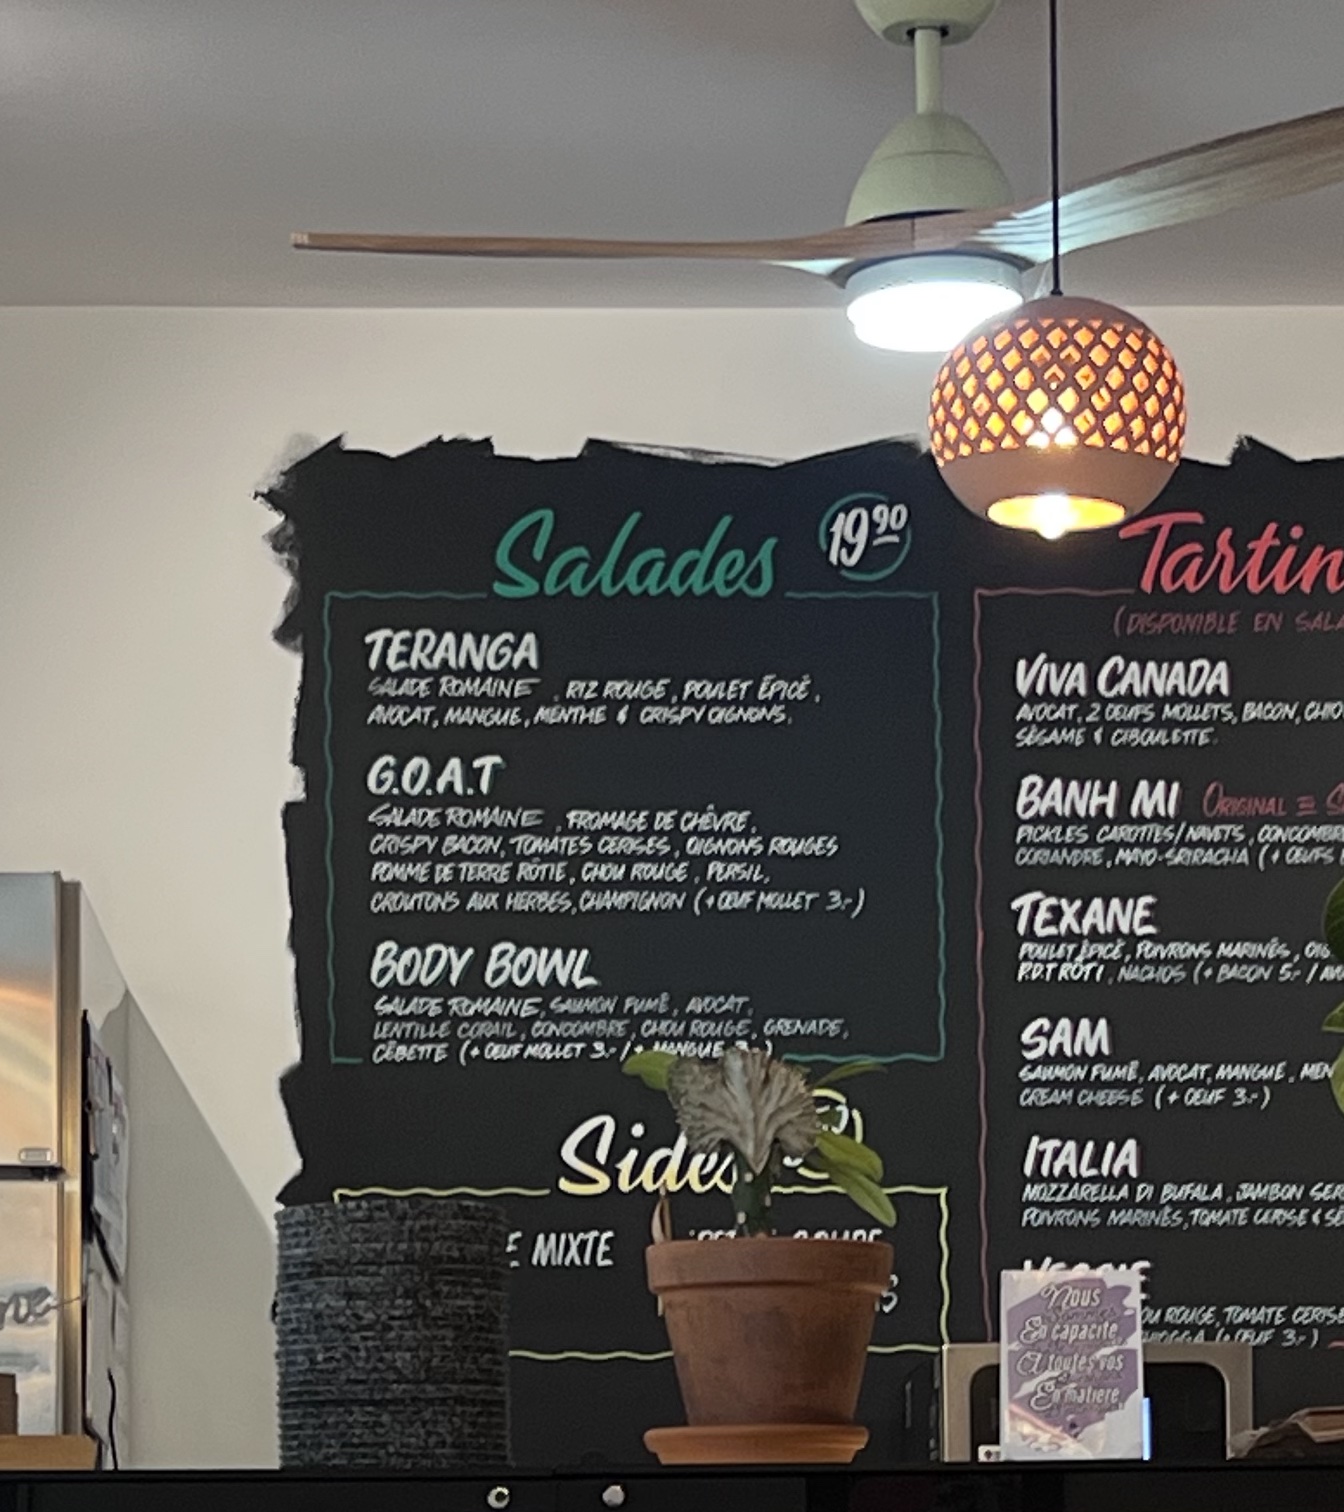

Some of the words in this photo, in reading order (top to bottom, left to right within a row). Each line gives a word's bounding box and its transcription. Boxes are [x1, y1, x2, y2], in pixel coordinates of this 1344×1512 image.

[493, 508, 778, 598] Salades
[1253, 610, 1282, 634] EN
[364, 628, 540, 672] TERANGA
[1016, 652, 1087, 698] VIVA
[1098, 655, 1231, 698] CANADA
[368, 677, 433, 698] SALADE
[566, 680, 598, 699] RIZ
[683, 680, 748, 699] POULET
[534, 706, 607, 724] MENTHE
[640, 706, 703, 724] CRISPY
[1087, 703, 1100, 722] 2
[1016, 774, 1117, 819] BANH
[1131, 780, 1182, 818] MI
[368, 804, 442, 828] SALADE
[566, 810, 649, 831] FROMAGE
[654, 812, 676, 830] DE
[1016, 823, 1088, 844] PICKLES
[369, 835, 438, 856] CRISPY
[510, 835, 593, 856] TOMATES
[685, 835, 763, 856] OIGNONS
[769, 835, 838, 856] ROUGES
[371, 862, 433, 883] POMME
[435, 862, 455, 883] DE
[459, 862, 513, 883] TERRE
[582, 862, 625, 881] CHOU
[467, 891, 499, 909] AUX
[580, 891, 685, 910] CHAMPIGNON
[757, 891, 812, 910] MOLLET
[1010, 891, 1159, 937] TEXANE
[1136, 942, 1212, 960] POIVRONS
[370, 940, 474, 988] BODY
[484, 940, 600, 988] BOWL
[1118, 965, 1186, 984] NACHOS
[374, 1021, 450, 1040] LENTILLE
[640, 1019, 685, 1037] CHOU
[1020, 1017, 1112, 1060] SAM
[524, 1043, 584, 1060] MOLLET
[1020, 1087, 1073, 1106] CREAM
[1077, 1087, 1143, 1105] CHEESE
[558, 1114, 736, 1195] Sides
[1023, 1135, 1141, 1179] ITALIA
[1022, 1184, 1129, 1202] MOZZARELLA
[1136, 1184, 1154, 1201] DI
[1237, 1184, 1304, 1201] JAMBON
[1022, 1208, 1100, 1228] POIVRONS
[1192, 1208, 1248, 1226] TOMATE
[532, 1231, 614, 1267] MIXTE
[1224, 1307, 1286, 1325] TOMATE
